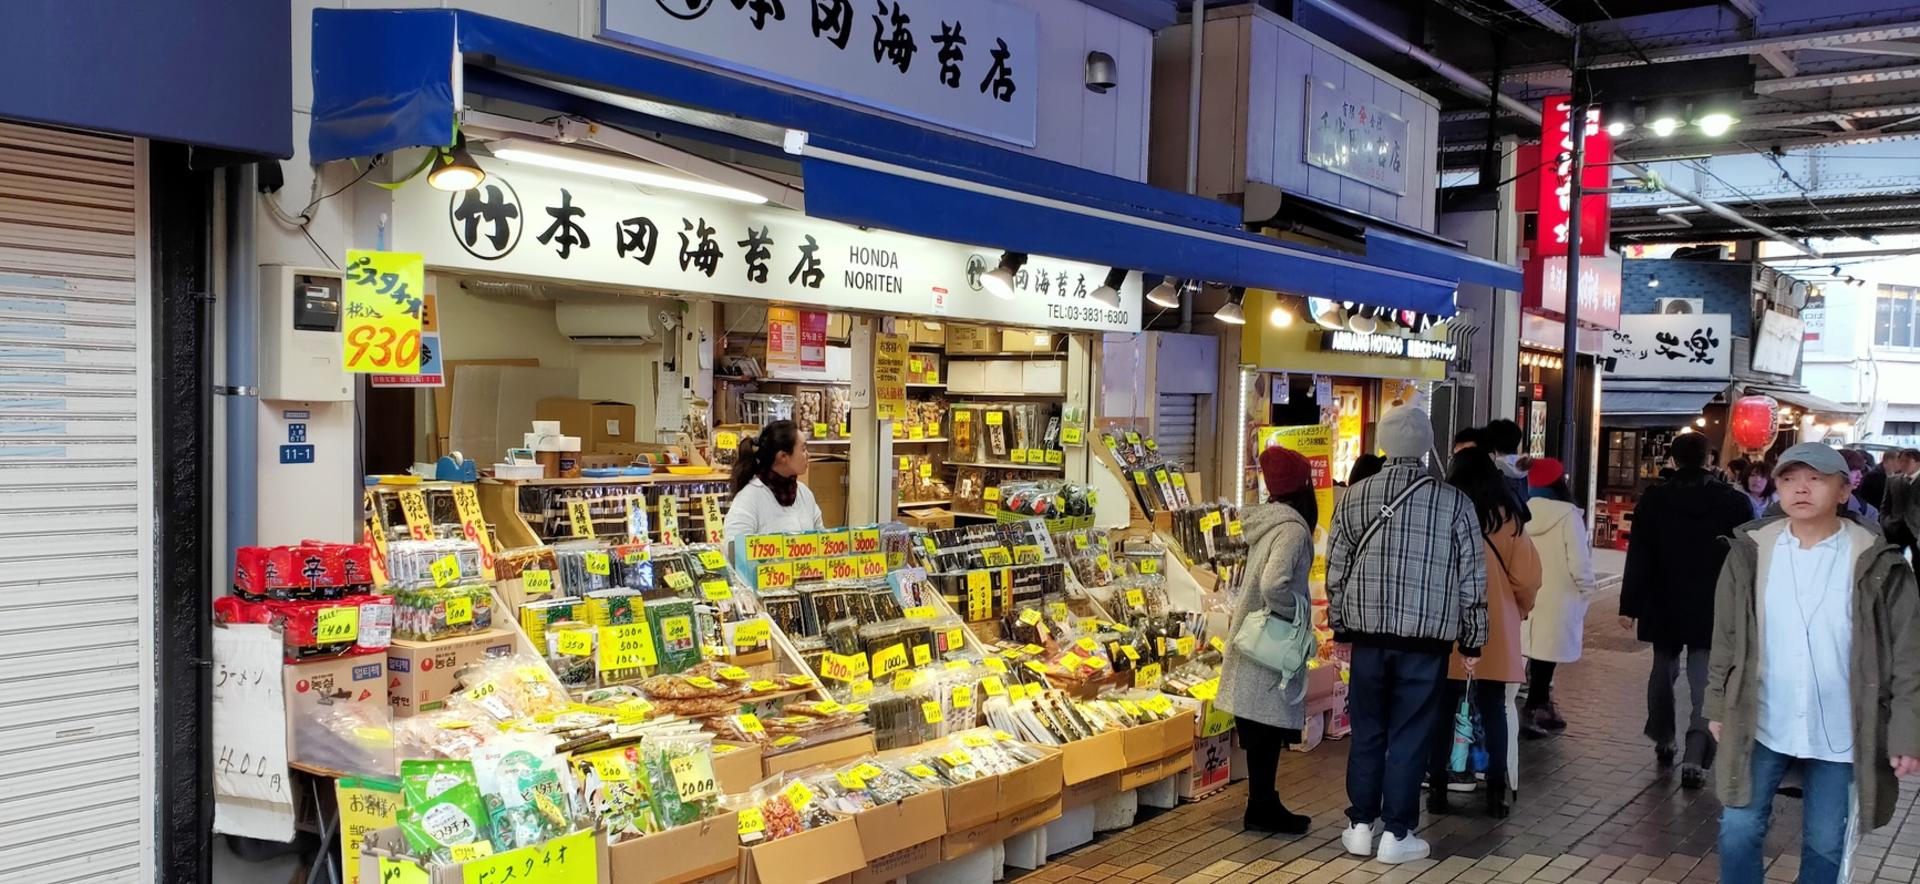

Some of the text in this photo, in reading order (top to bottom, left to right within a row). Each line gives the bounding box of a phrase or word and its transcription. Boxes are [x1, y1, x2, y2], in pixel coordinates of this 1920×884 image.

[849, 245, 898, 270] HONDA
[844, 269, 902, 294] NORITEN
[1047, 303, 1128, 326] TEL:03-3831-6300
[346, 325, 421, 368] 930
[1370, 334, 1404, 355] HOTDOG
[285, 448, 311, 460] 11-1
[752, 543, 781, 558] 1750円
[788, 542, 817, 556] 2000円
[823, 540, 849, 555] 2500円
[855, 537, 879, 551] 3000円
[302, 556, 326, 593] 辛
[832, 565, 856, 579] 500円
[863, 562, 884, 575] 600円
[765, 572, 790, 586] 350円
[434, 656, 456, 669] 농심
[350, 792, 397, 818] お客様へ
